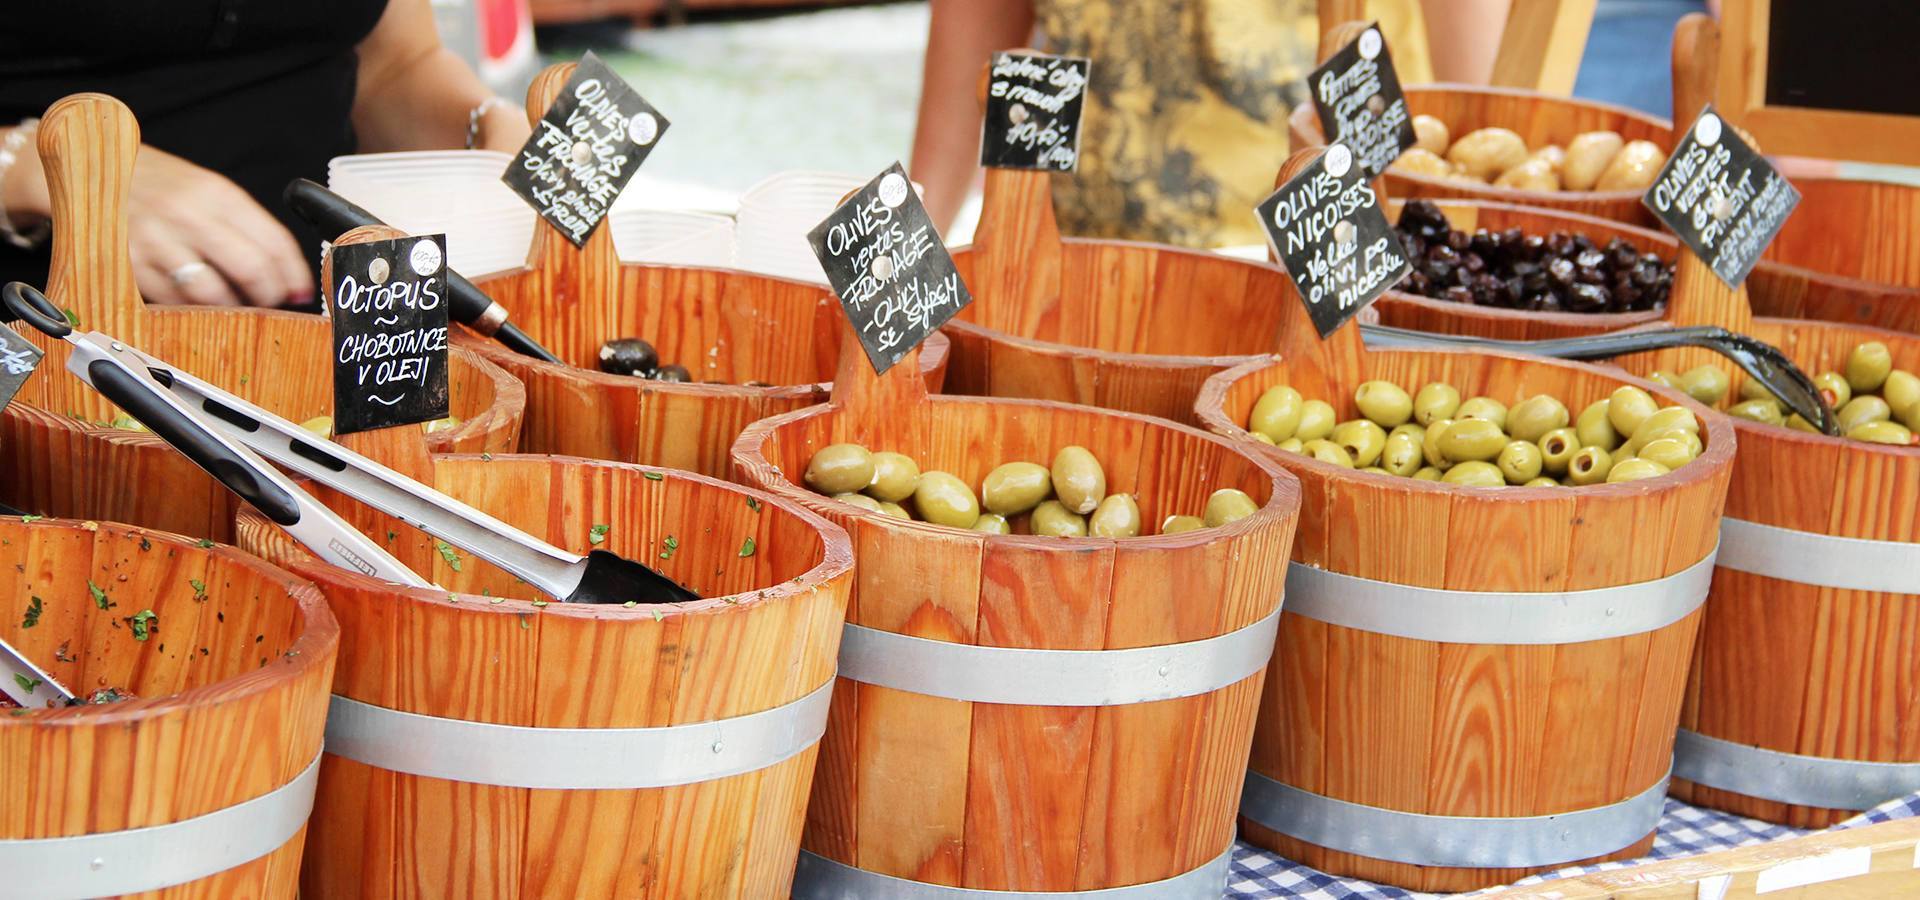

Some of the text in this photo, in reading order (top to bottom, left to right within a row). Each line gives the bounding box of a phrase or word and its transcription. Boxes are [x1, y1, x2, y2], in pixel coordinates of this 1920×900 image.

[575, 79, 629, 142] OLIVES
[1274, 172, 1342, 229] OLIVES
[1655, 142, 1707, 212] OLIVES
[1676, 143, 1731, 213] VERTES
[827, 197, 892, 256] OLIVES
[852, 222, 905, 274] vertes
[1364, 237, 1388, 273] po
[338, 275, 440, 313] OCTOPUS
[339, 327, 447, 363] CHOBOTNICE
[359, 356, 429, 387] V OLEJI
